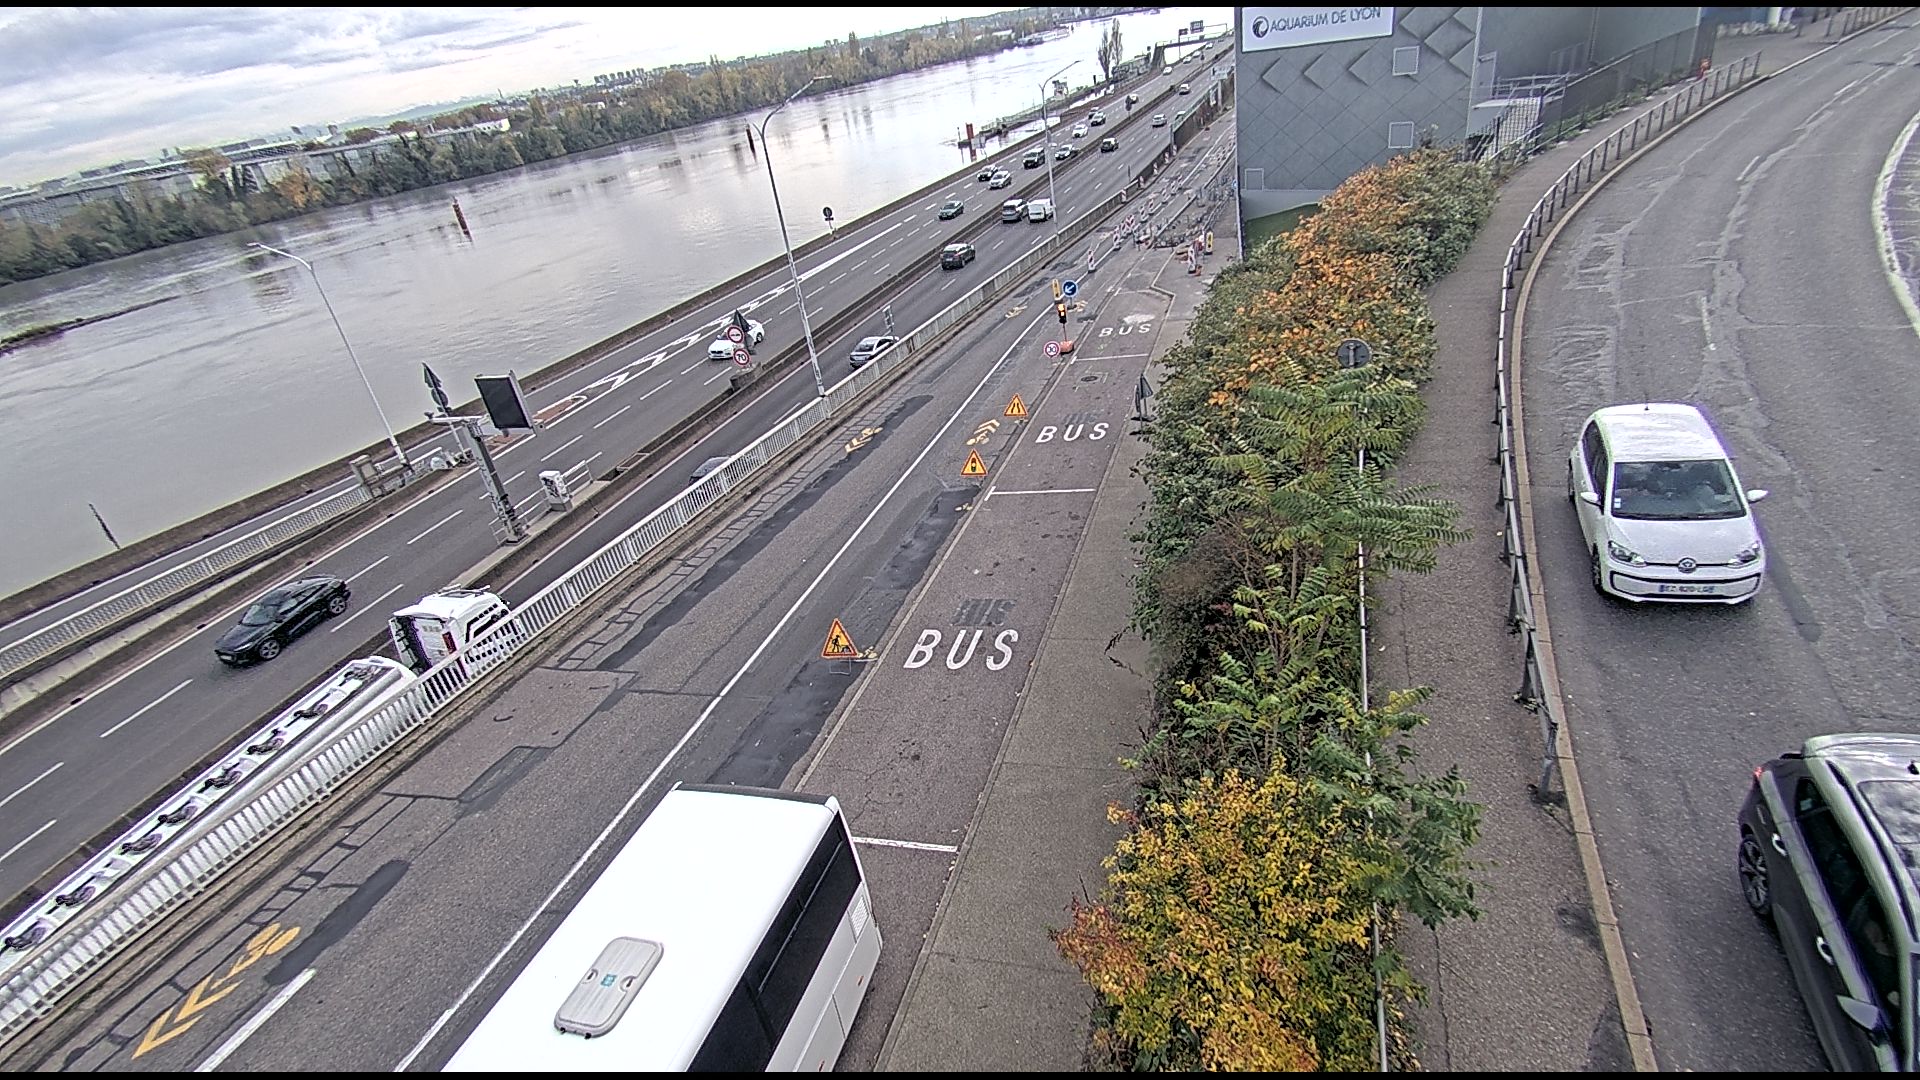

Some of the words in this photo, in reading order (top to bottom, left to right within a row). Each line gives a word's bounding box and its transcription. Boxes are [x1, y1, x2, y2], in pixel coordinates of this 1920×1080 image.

[1331, 9, 1347, 25] DE
[1349, 7, 1381, 22] LYON
[1098, 323, 1152, 337] BUS
[1035, 422, 1109, 443] BUS
[903, 628, 1019, 671] BUS
